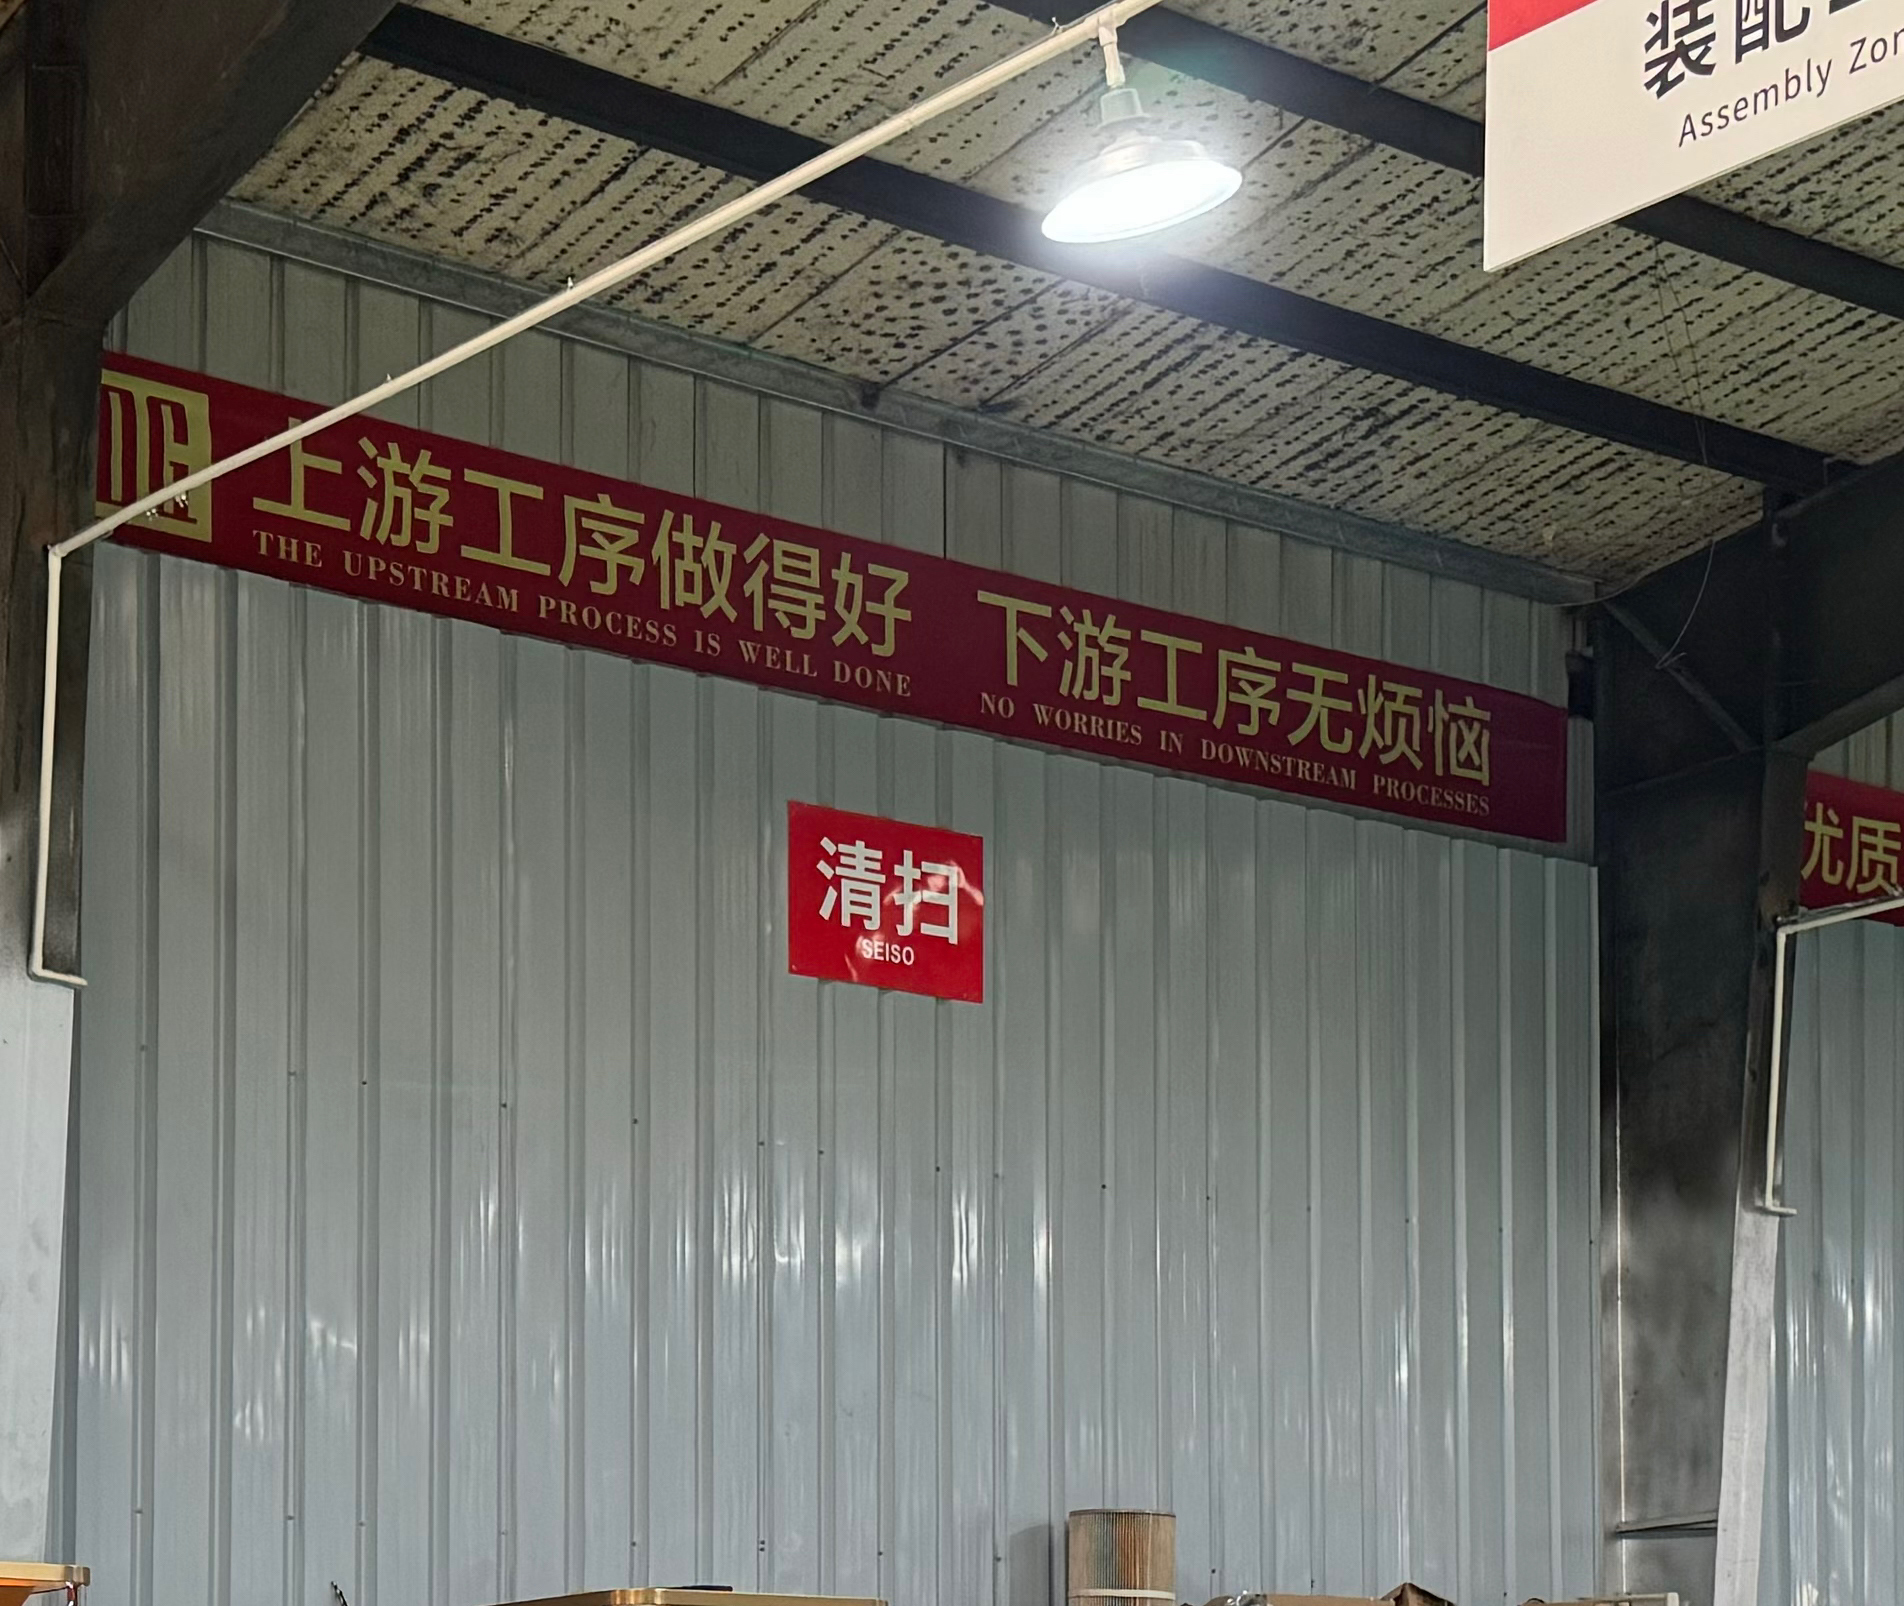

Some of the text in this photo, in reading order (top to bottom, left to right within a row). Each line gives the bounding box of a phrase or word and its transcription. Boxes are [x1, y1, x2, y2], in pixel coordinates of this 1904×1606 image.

[1643, 0, 1870, 99] 装配
[1678, 57, 1833, 148] Assembly
[252, 416, 1492, 786] 上游工序做得好 下游工序无烦恼
[252, 529, 1491, 817] THE UPSTREAM PROCESS IS WELL DONE NO WORRIES IN DOWNSTREAM PROCESSES
[816, 836, 958, 945] 清扫
[861, 938, 915, 966] SEISO
